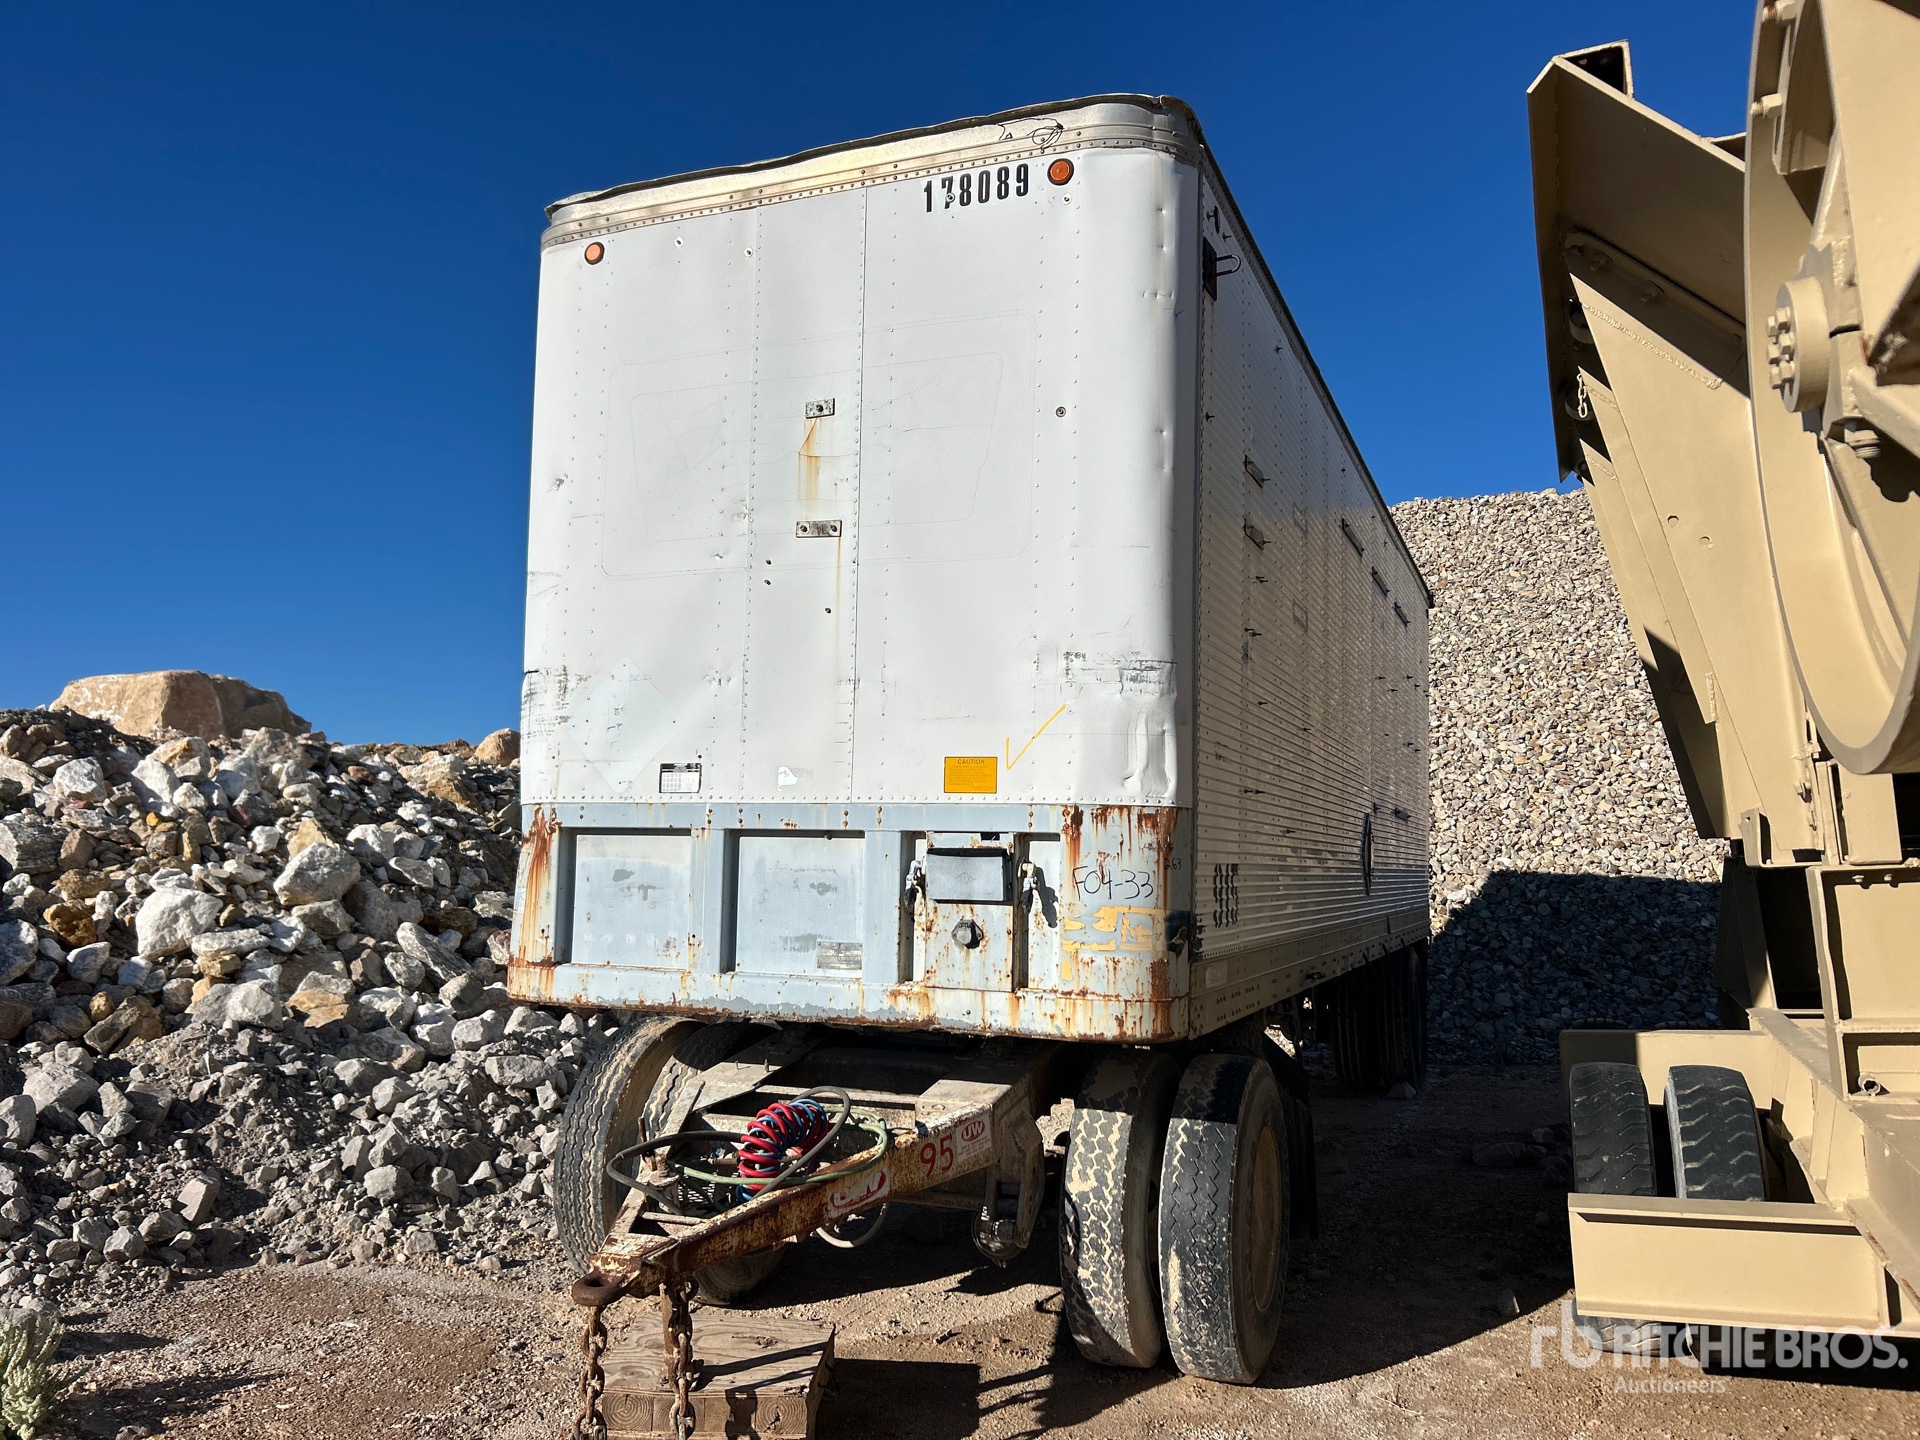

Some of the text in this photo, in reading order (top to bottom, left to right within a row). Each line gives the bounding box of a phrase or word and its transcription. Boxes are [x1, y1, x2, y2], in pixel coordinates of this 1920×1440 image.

[923, 163, 1029, 213] 178089
[962, 1121, 984, 1141] UW
[920, 1132, 954, 1178] 95
